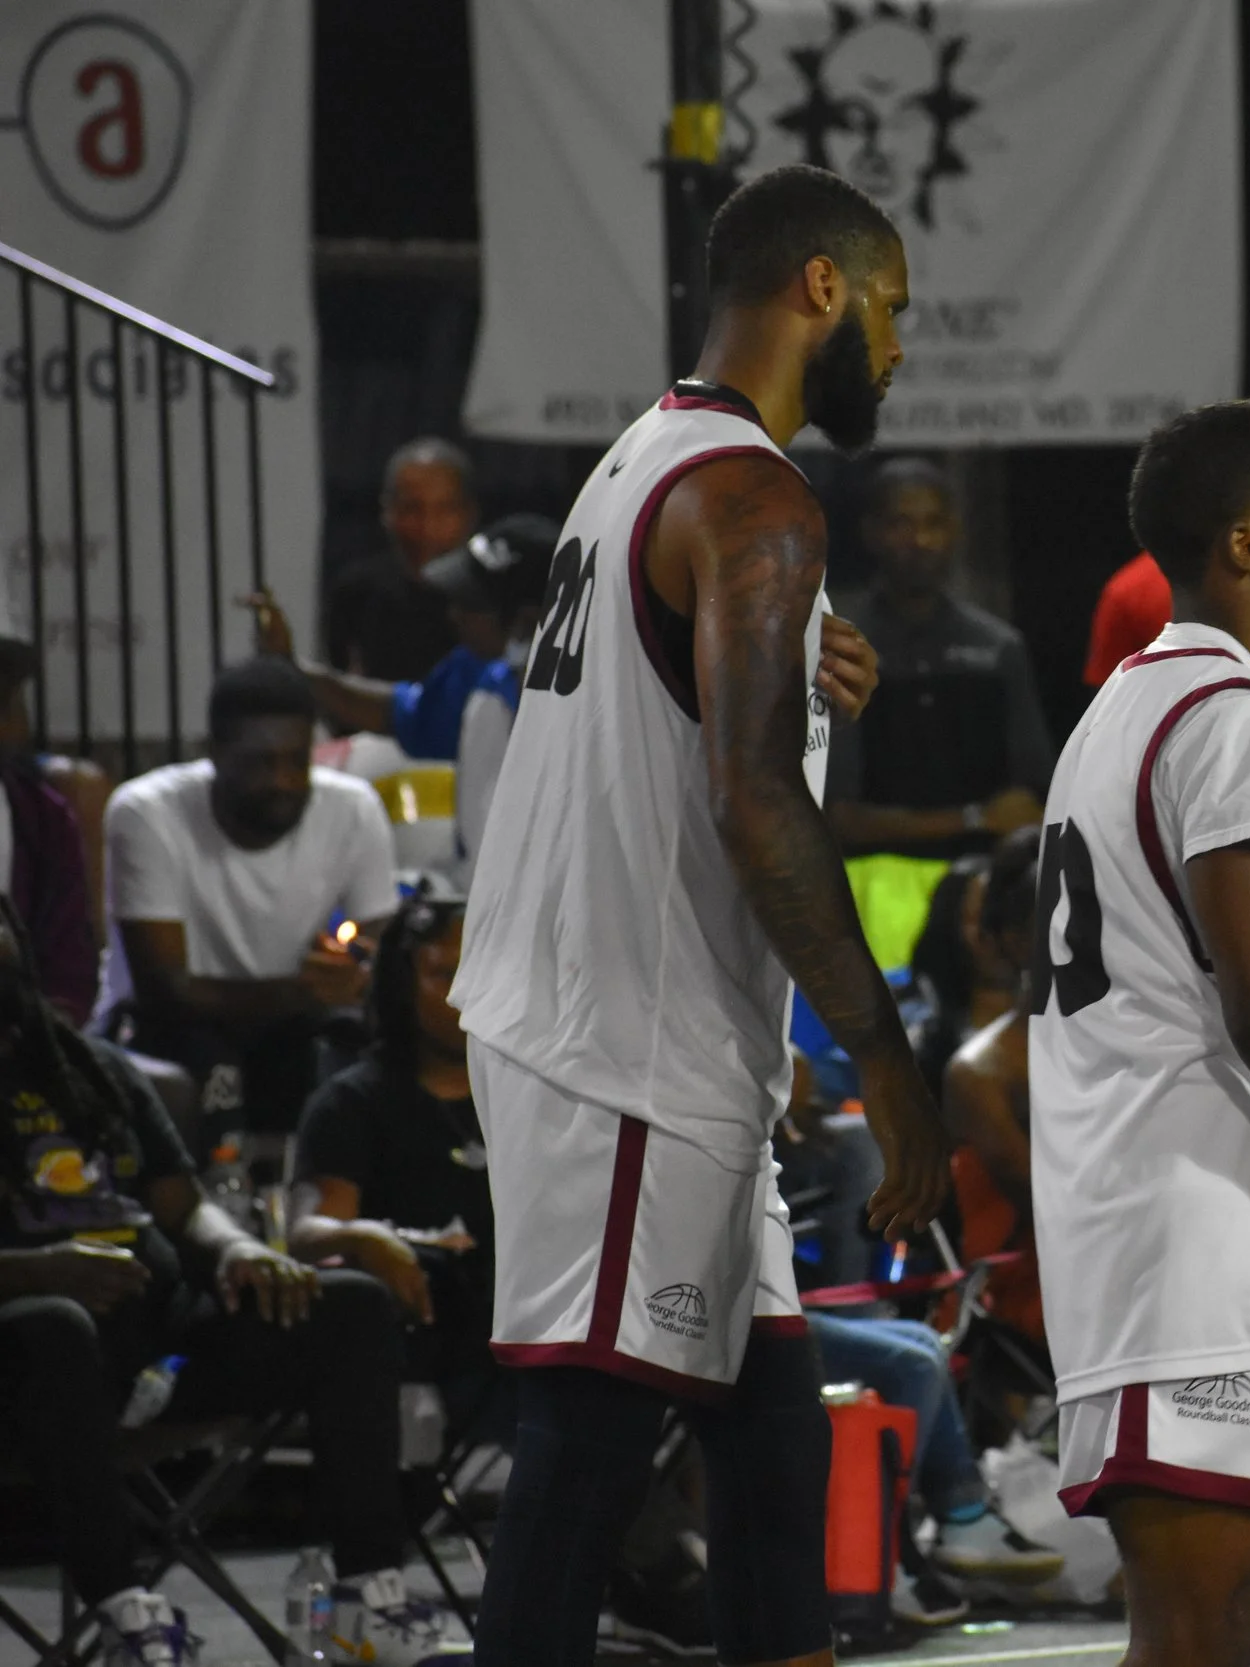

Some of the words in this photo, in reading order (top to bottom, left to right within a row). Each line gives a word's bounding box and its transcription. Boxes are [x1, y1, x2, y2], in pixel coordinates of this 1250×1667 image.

[75, 59, 145, 180] a
[526, 536, 599, 696] 20
[1171, 1391, 1213, 1409] George
[1177, 1407, 1229, 1423] Roundball
